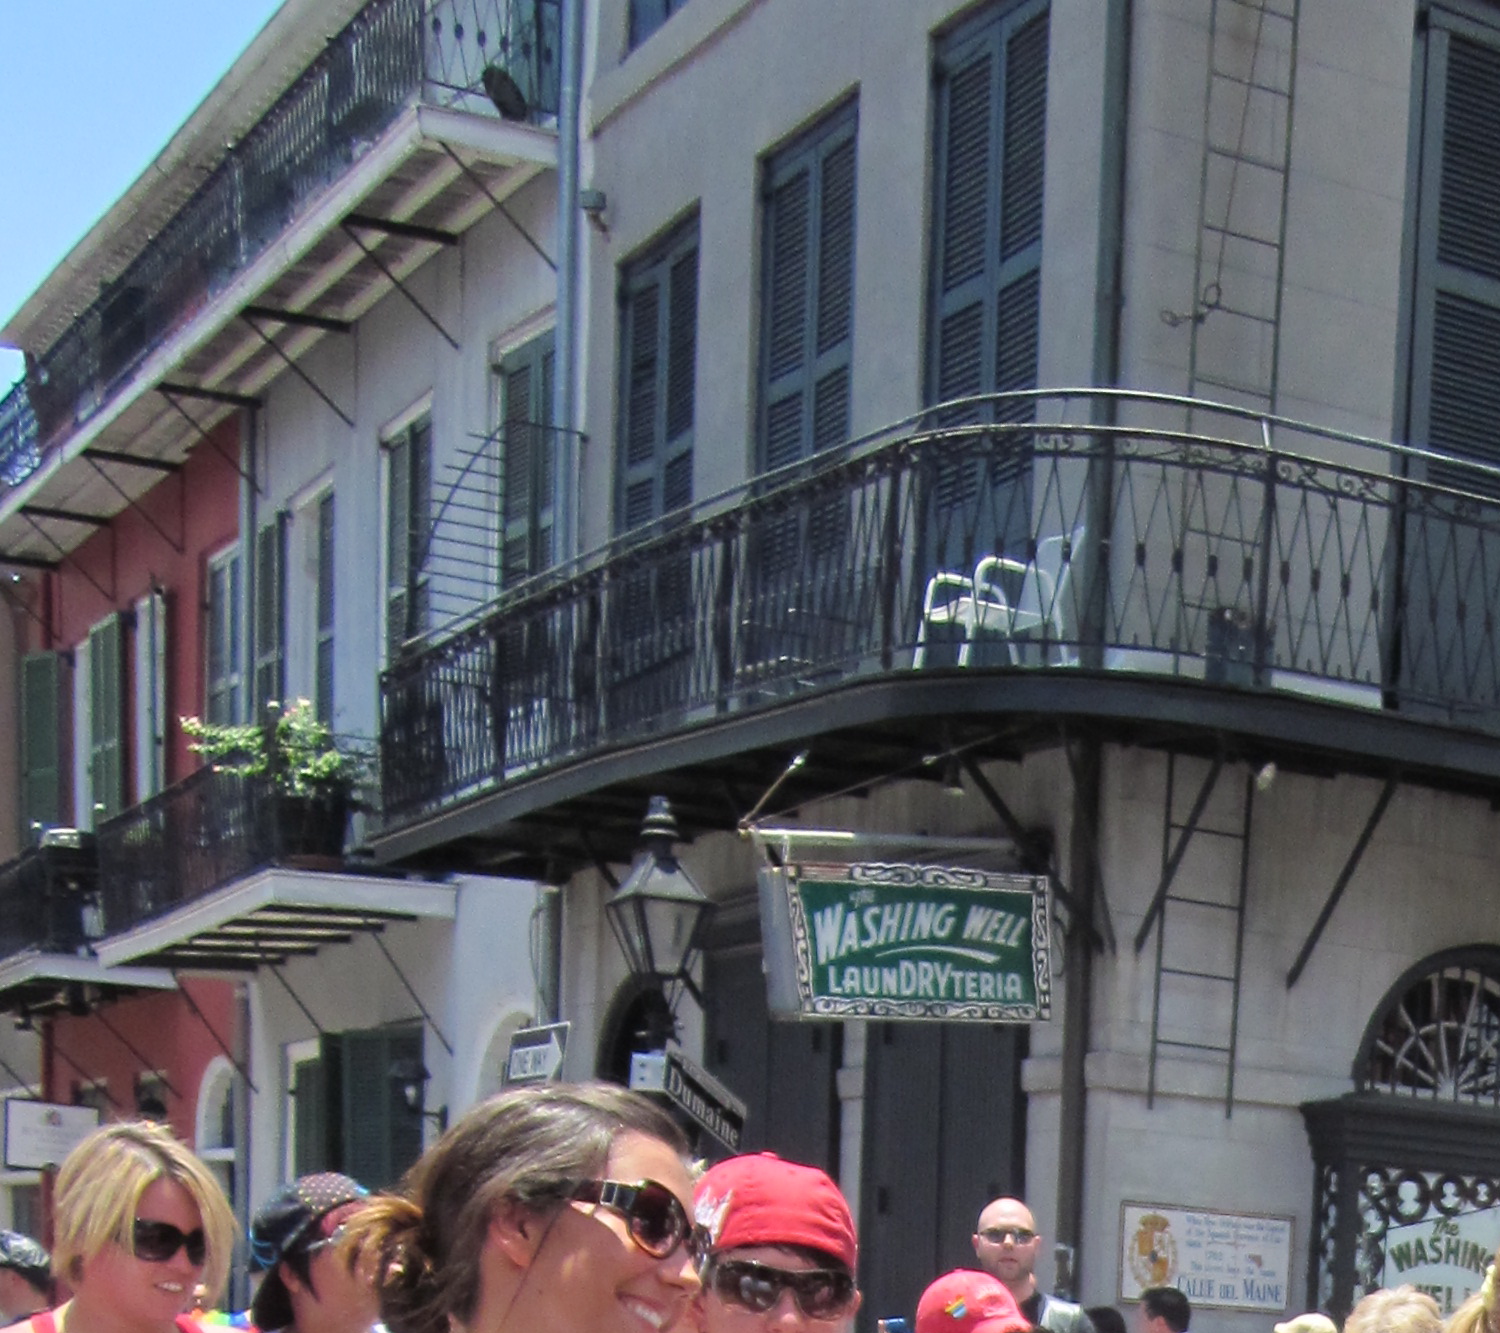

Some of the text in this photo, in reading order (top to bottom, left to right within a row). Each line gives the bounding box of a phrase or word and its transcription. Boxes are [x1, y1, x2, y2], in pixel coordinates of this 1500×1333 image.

[813, 902, 1028, 965] WASHING WELL
[828, 959, 1023, 1000] LAUNDRYTERIA
[669, 1066, 739, 1147] Dumaine
[1431, 1217, 1461, 1236] The
[1242, 1278, 1283, 1303] MAINE
